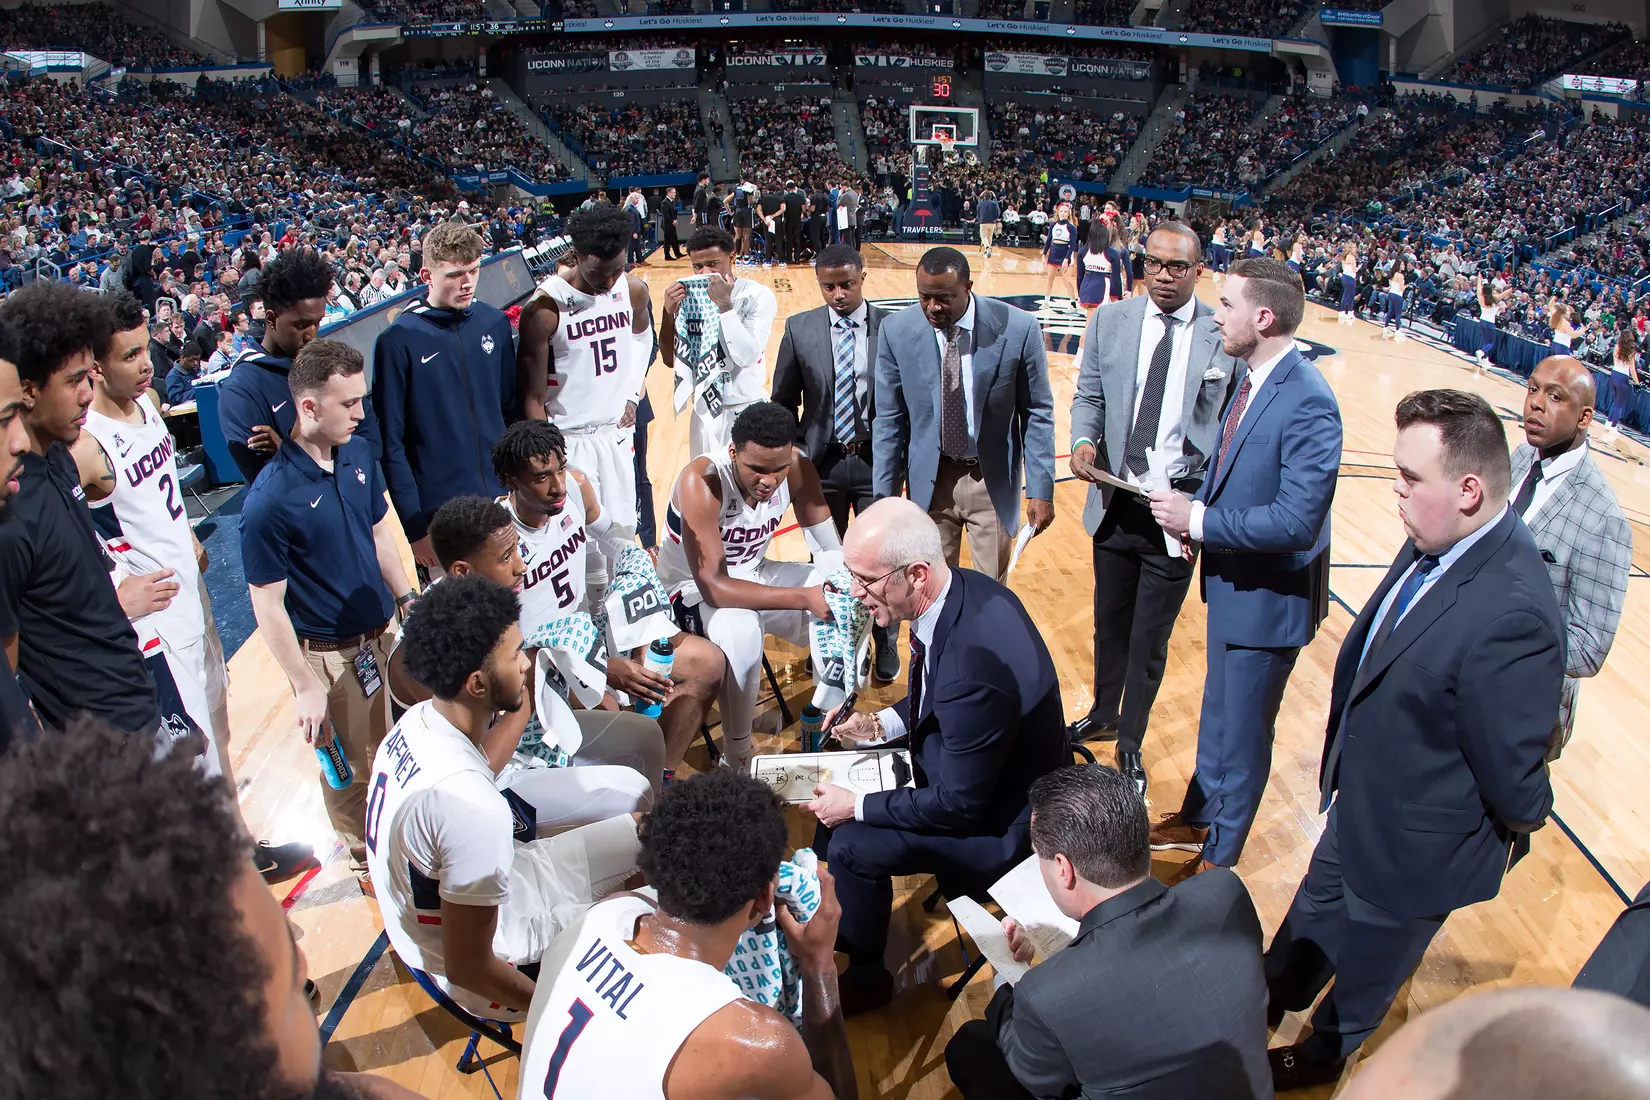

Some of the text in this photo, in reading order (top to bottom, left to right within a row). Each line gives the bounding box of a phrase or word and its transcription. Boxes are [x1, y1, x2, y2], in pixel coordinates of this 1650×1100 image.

[1020, 24, 1050, 32] Huskies!
[1133, 31, 1162, 40] Huskies!
[1212, 36, 1230, 44] Let's
[527, 60, 566, 70] UCONN
[726, 56, 772, 66] UCONN
[910, 59, 954, 68] HUSKIES
[1072, 63, 1108, 74] UCONN
[933, 76, 952, 84] 11:57
[933, 83, 950, 97] 30
[902, 226, 944, 234] TRAVELERS
[566, 310, 631, 341] UCONN
[590, 336, 618, 377] 15
[158, 473, 184, 521] 2
[522, 526, 587, 590] UCONN
[726, 540, 766, 567] 25
[550, 568, 576, 609] 5
[385, 723, 422, 790] AFFNEY
[366, 772, 388, 858] 0
[576, 938, 644, 1020] VITAL
[543, 996, 594, 1100] 1
